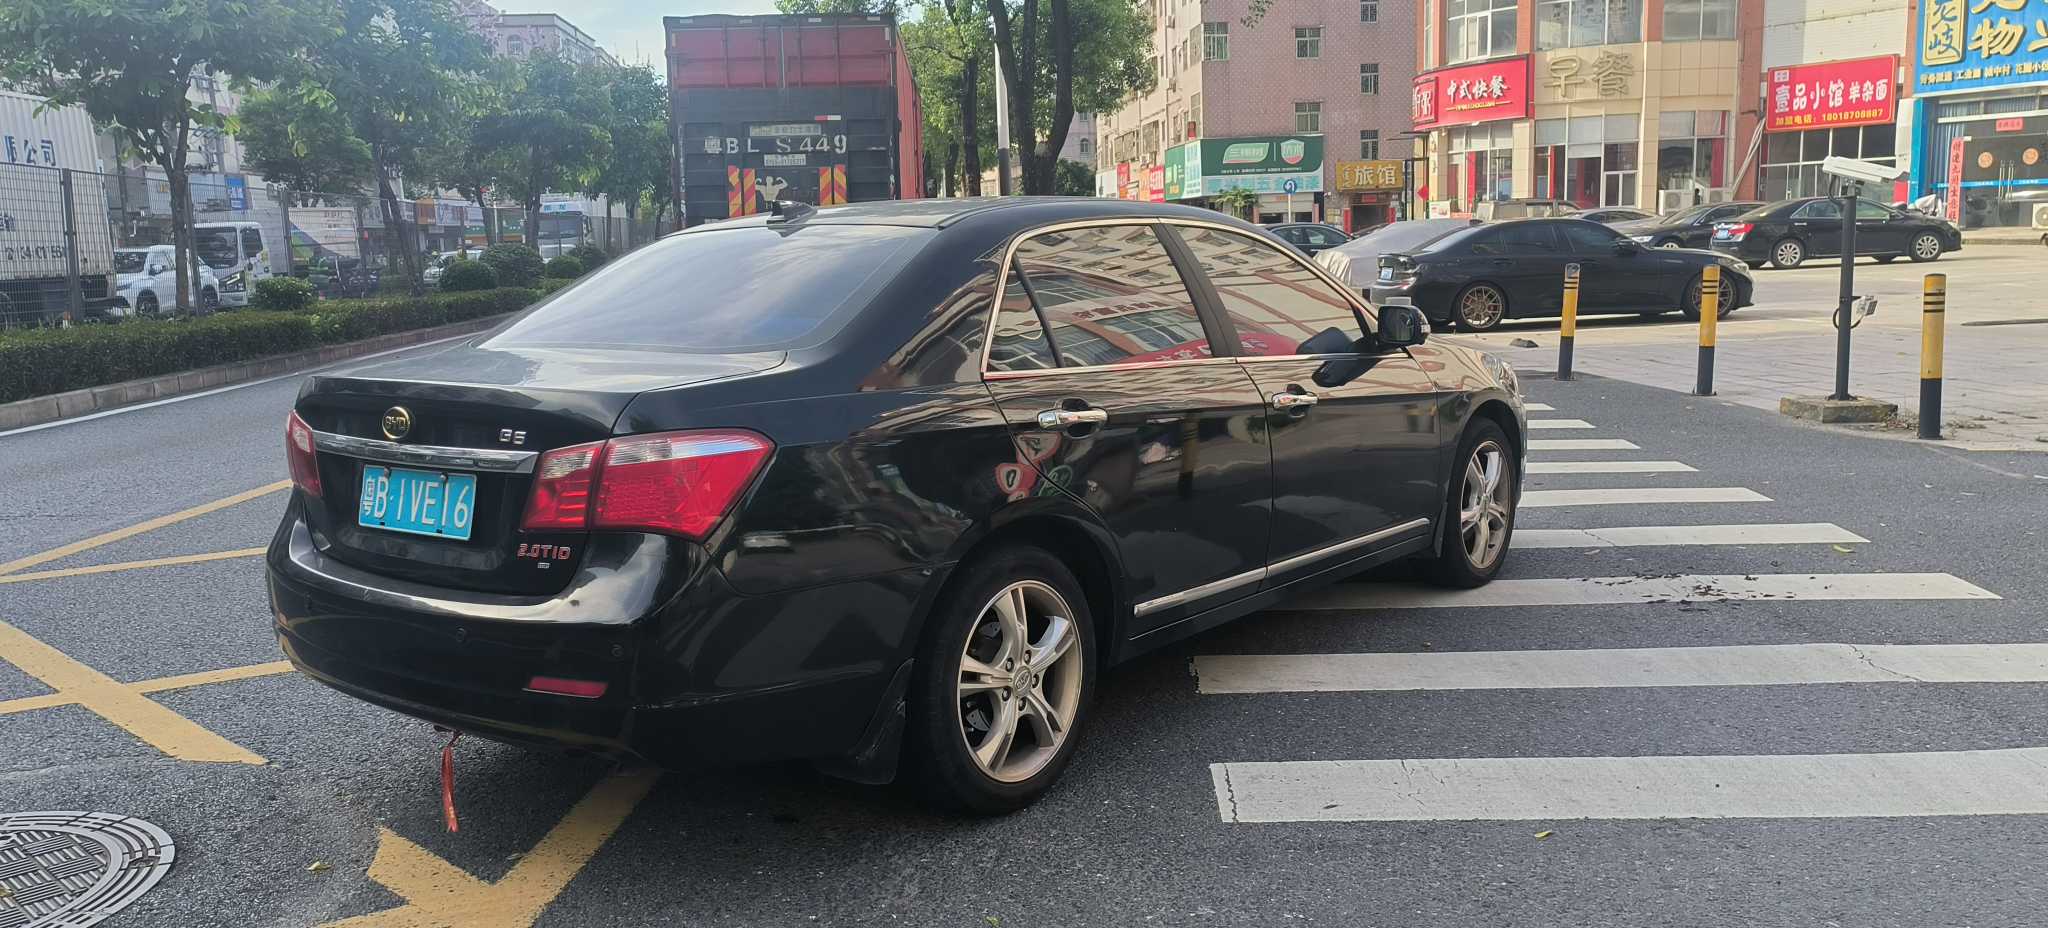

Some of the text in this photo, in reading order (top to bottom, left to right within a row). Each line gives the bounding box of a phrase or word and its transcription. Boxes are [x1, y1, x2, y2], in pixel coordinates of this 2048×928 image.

[1543, 50, 1633, 97] 早餐
[1447, 76, 1508, 104] 中式快餐
[1775, 79, 1888, 113] 壹品小馆 羊杂面
[1355, 164, 1396, 185] 旅馆
[499, 428, 527, 445] G6
